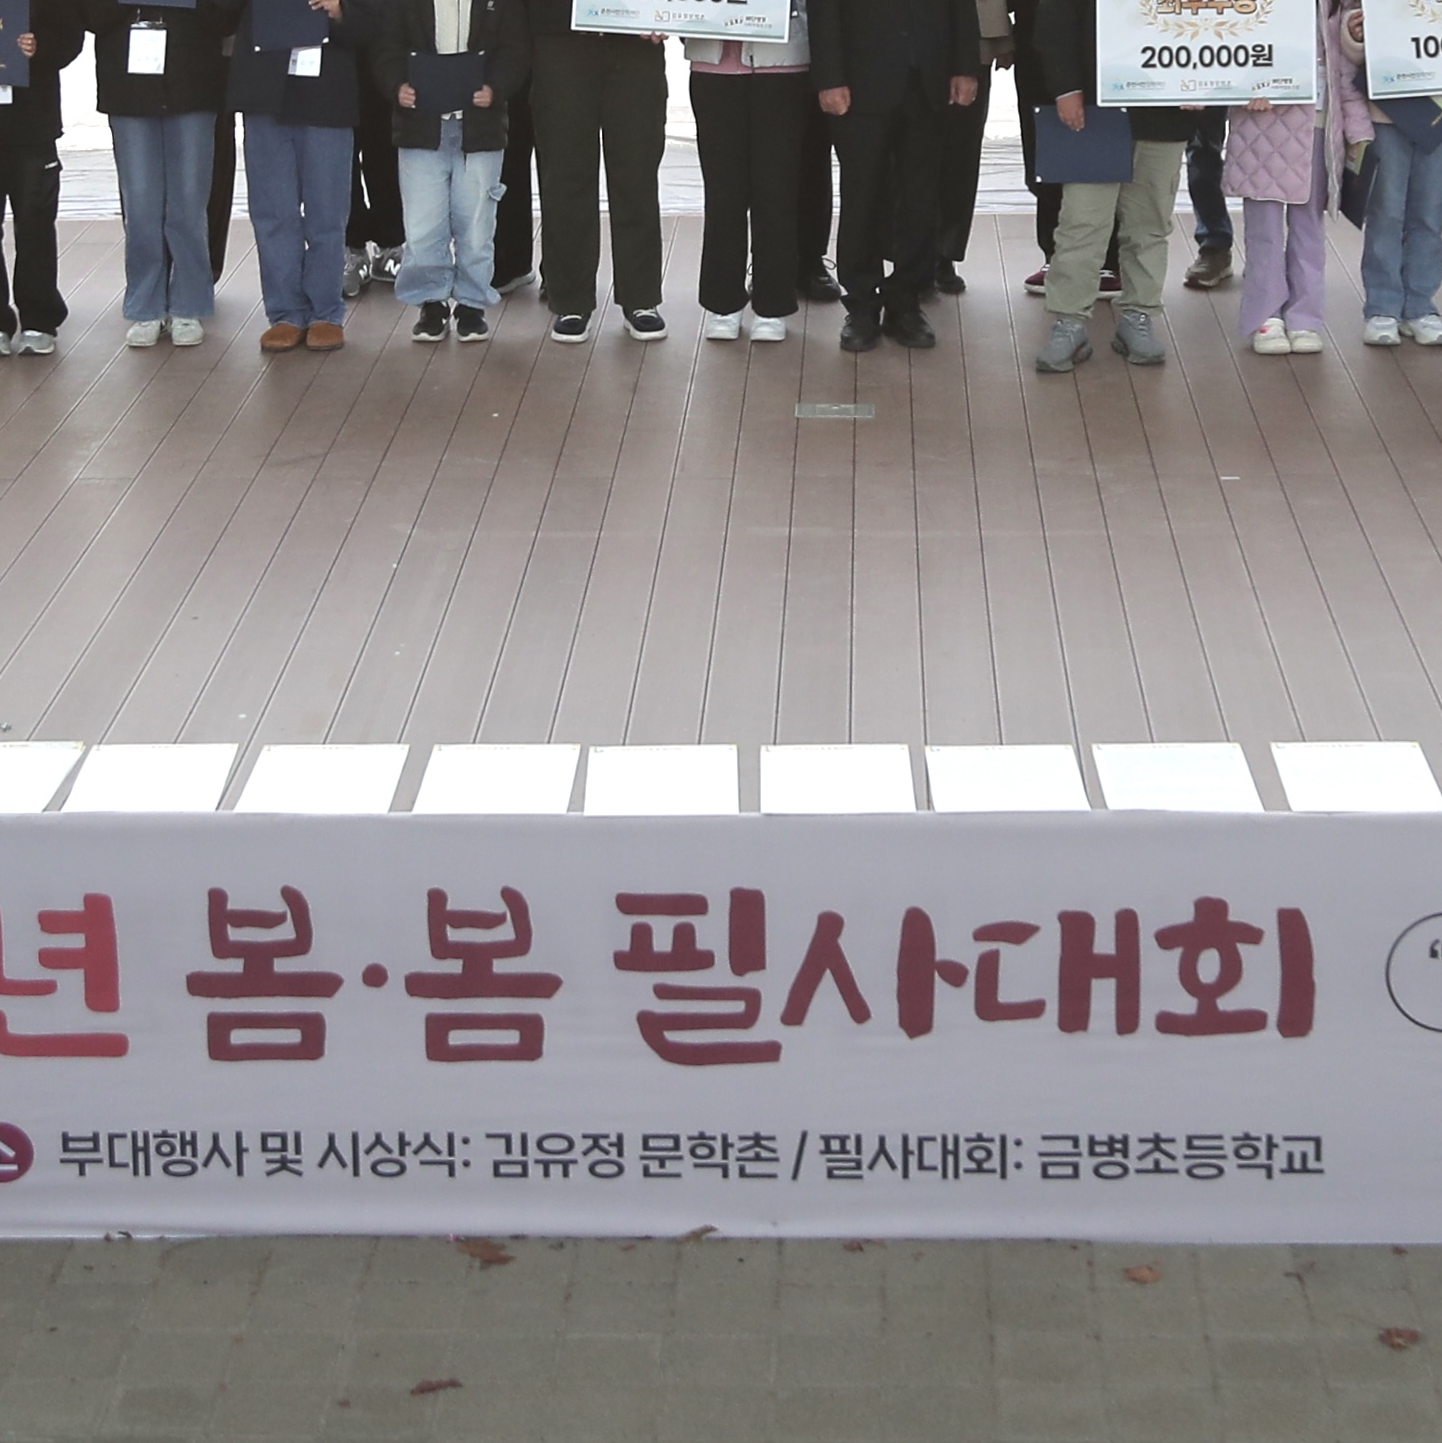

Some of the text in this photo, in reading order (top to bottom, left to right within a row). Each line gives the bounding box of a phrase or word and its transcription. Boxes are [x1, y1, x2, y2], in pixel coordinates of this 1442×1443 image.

[1140, 43, 1274, 70] 200,000원
[185, 884, 564, 1064] 봄·봄
[612, 886, 1317, 1068] 필사대회
[59, 1129, 250, 1179] 부대행사
[259, 1130, 304, 1178] 및
[316, 1130, 472, 1179] 시상식:
[484, 1131, 626, 1180] 김유정
[638, 1130, 781, 1181] 문학촌
[818, 1132, 1024, 1181] 필사대회:
[1037, 1131, 1326, 1182] 금병초등학교
